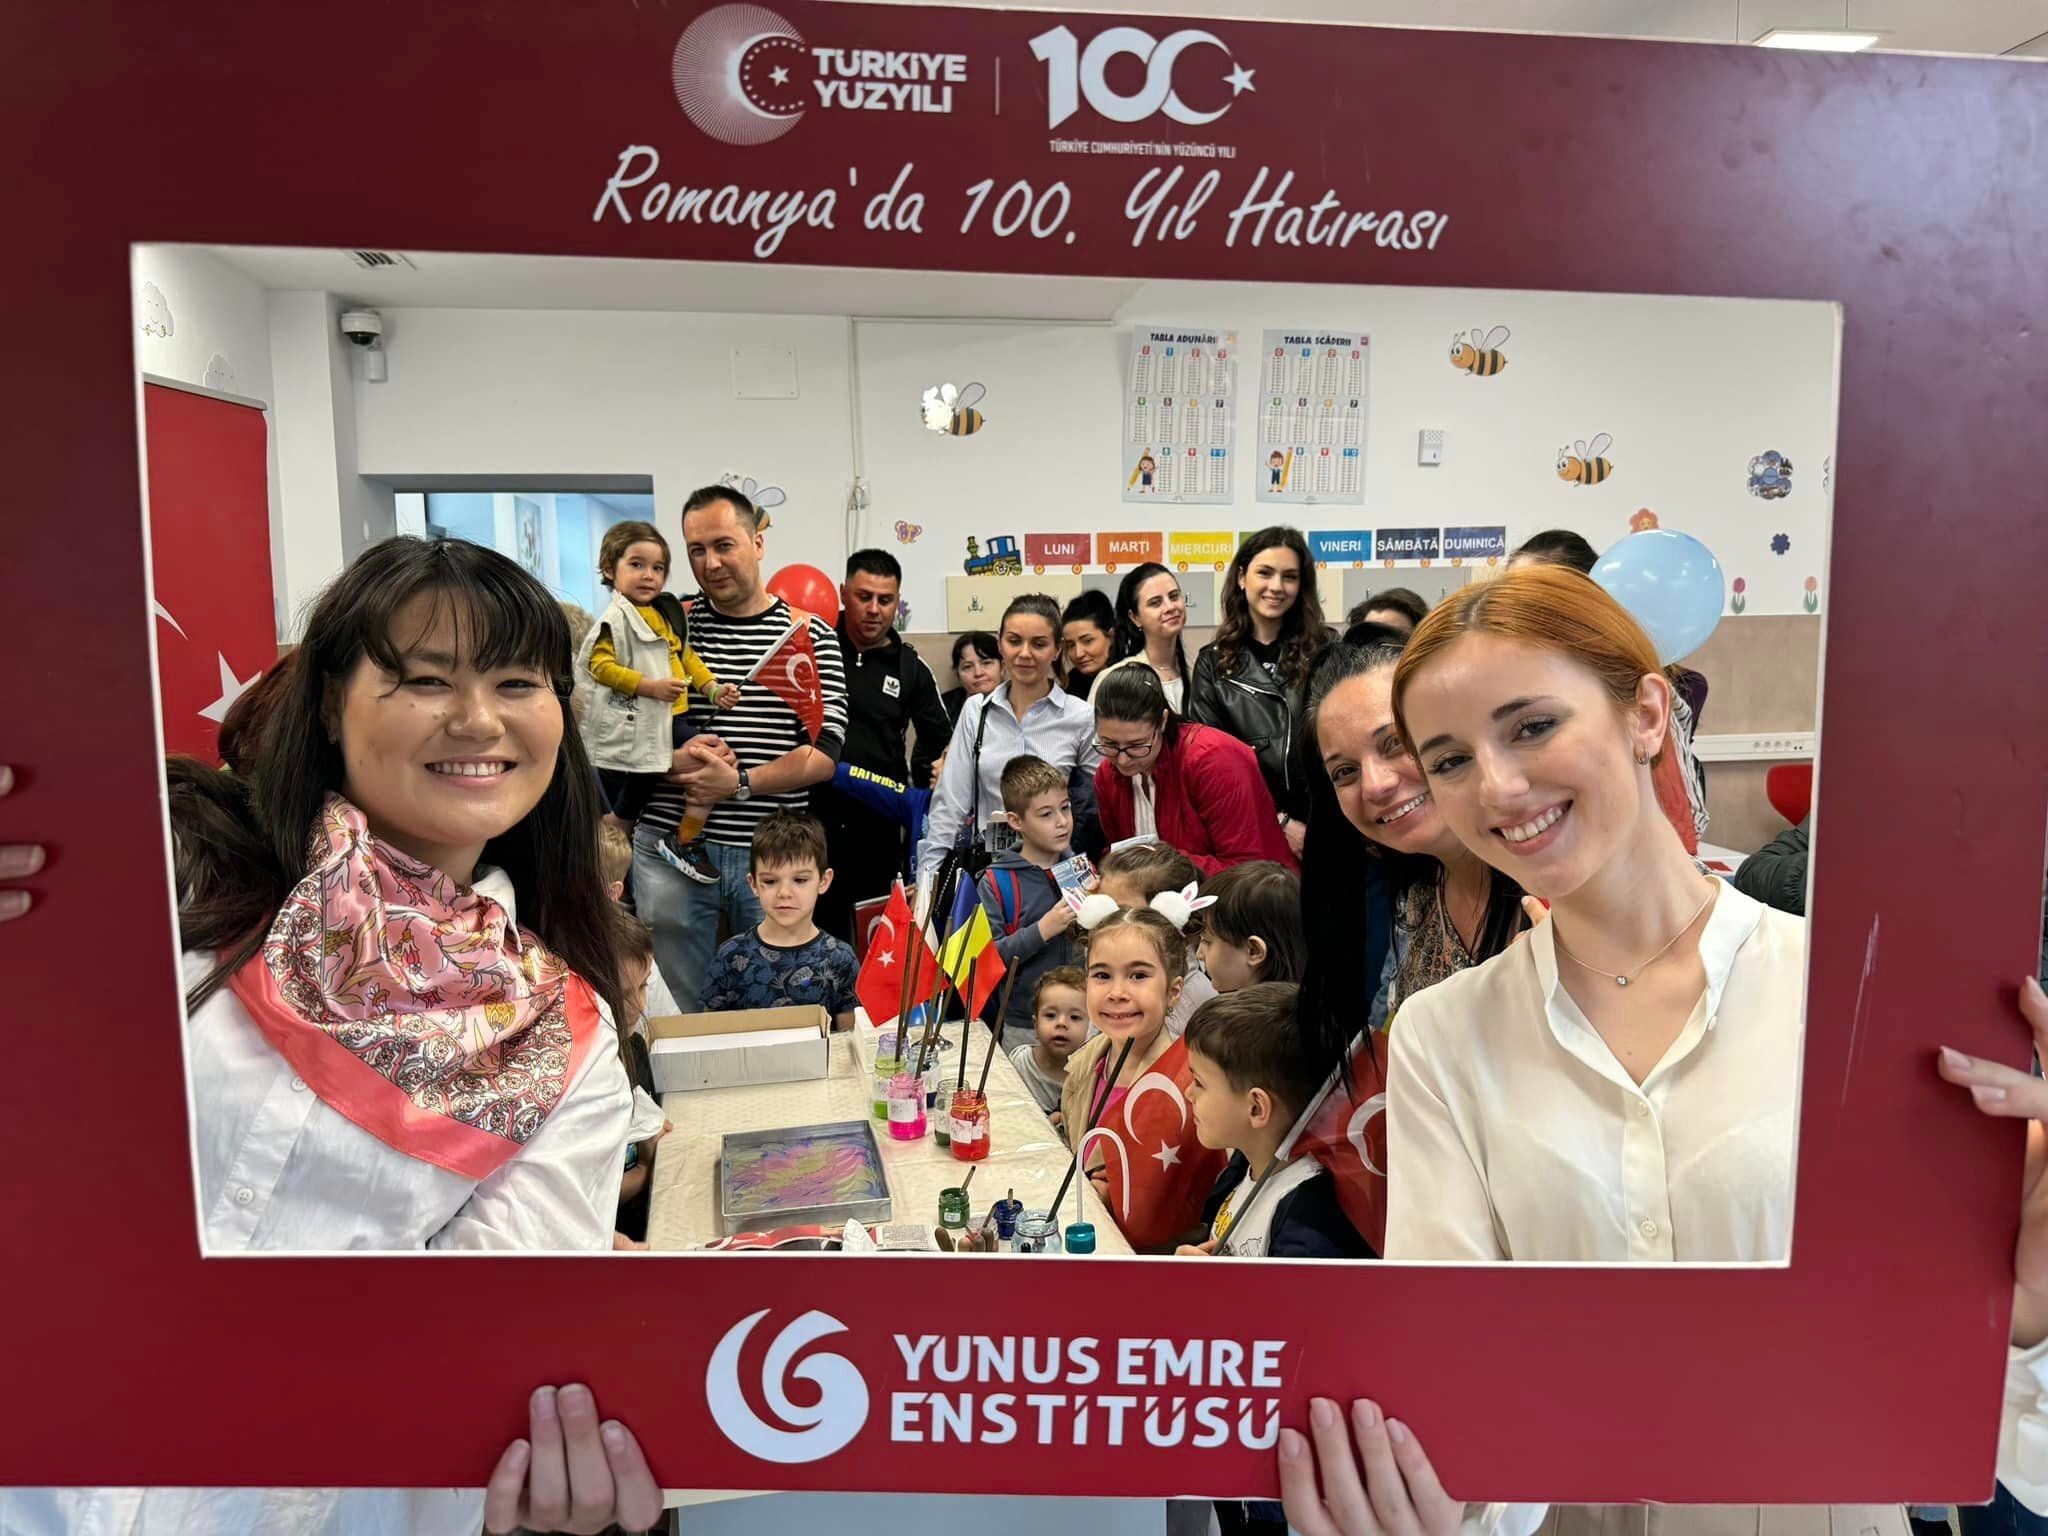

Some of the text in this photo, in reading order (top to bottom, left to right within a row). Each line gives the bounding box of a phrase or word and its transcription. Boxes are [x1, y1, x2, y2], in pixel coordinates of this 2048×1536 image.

[812, 47, 968, 82] TÜRKİYE
[813, 79, 952, 113] YÜZYILI
[1049, 138, 1089, 154] TÜRKİYE
[1173, 142, 1216, 158] YÜZÜNCÜ
[1218, 146, 1237, 159] YILI
[593, 144, 1449, 258] Romanya'da 100. Yıl Hatırası
[1150, 332, 1174, 342] TABLA
[1284, 335, 1312, 345] TABLA
[1044, 542, 1075, 556] LUNI
[1170, 542, 1232, 555] MIERCURI
[1320, 540, 1361, 552] VINERI
[1376, 536, 1439, 552] SÂMBĂTĂ
[1444, 536, 1505, 550] DUMINICĂ
[893, 1333, 1288, 1388] YUNUS EMRE
[890, 1391, 1280, 1451] ENSTİTÜSÜ
